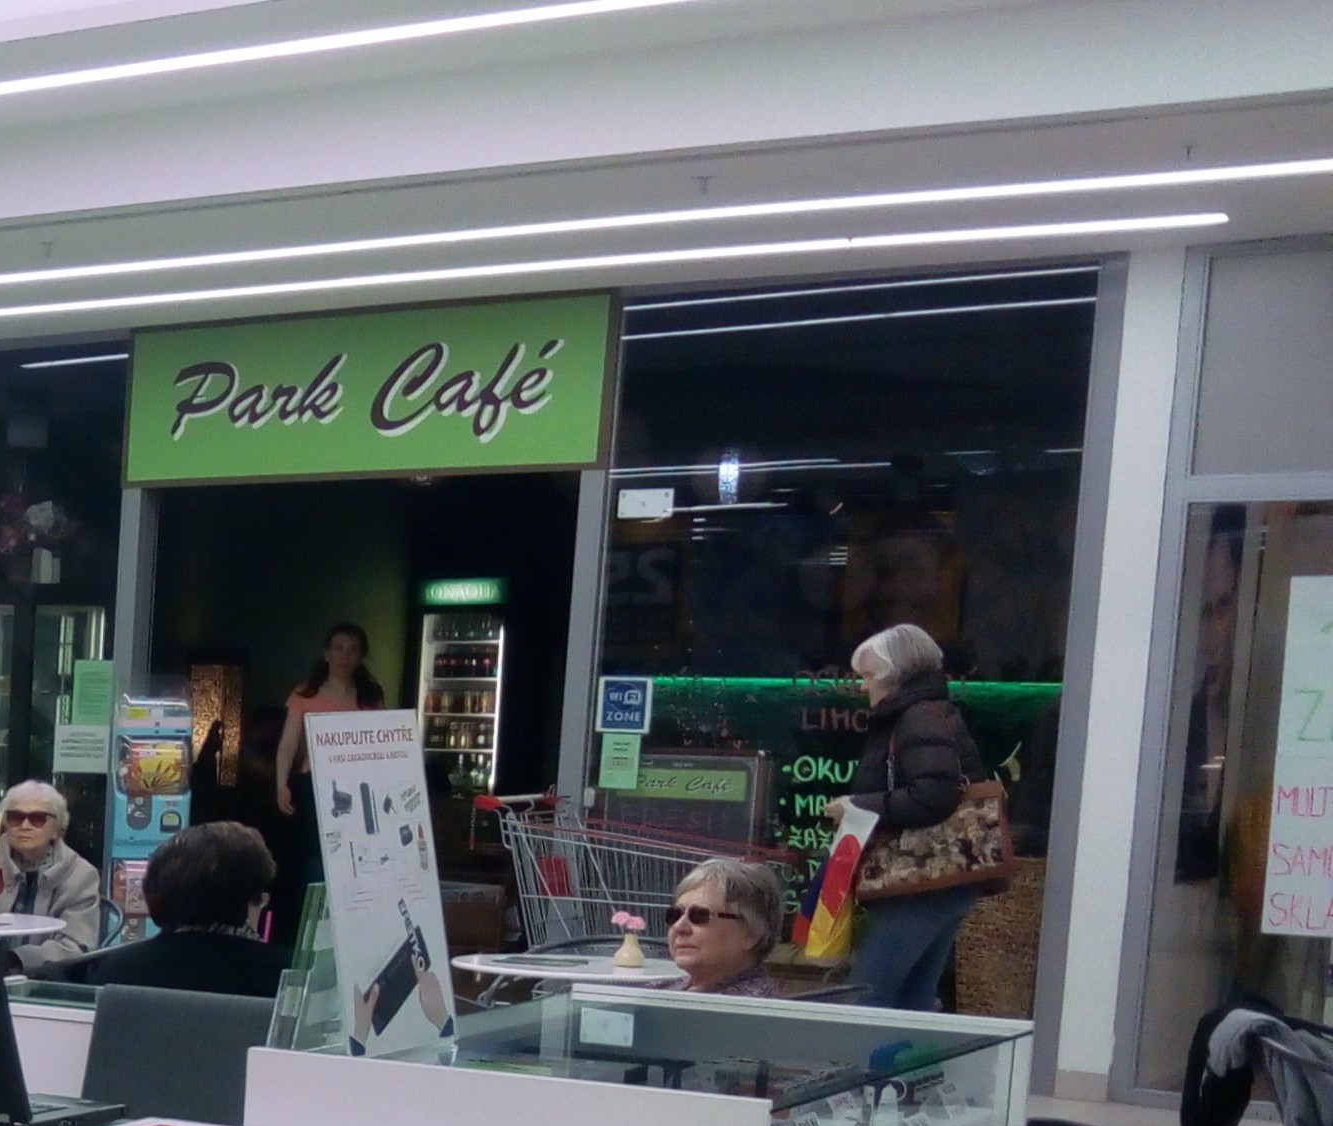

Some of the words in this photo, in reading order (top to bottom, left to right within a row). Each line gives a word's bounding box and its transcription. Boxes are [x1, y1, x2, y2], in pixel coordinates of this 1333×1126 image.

[170, 352, 348, 441] Park
[369, 338, 565, 443] Café
[606, 711, 641, 722] ZONE
[316, 729, 375, 747] NAKUPUJTE
[376, 725, 414, 743] CHYTŘE
